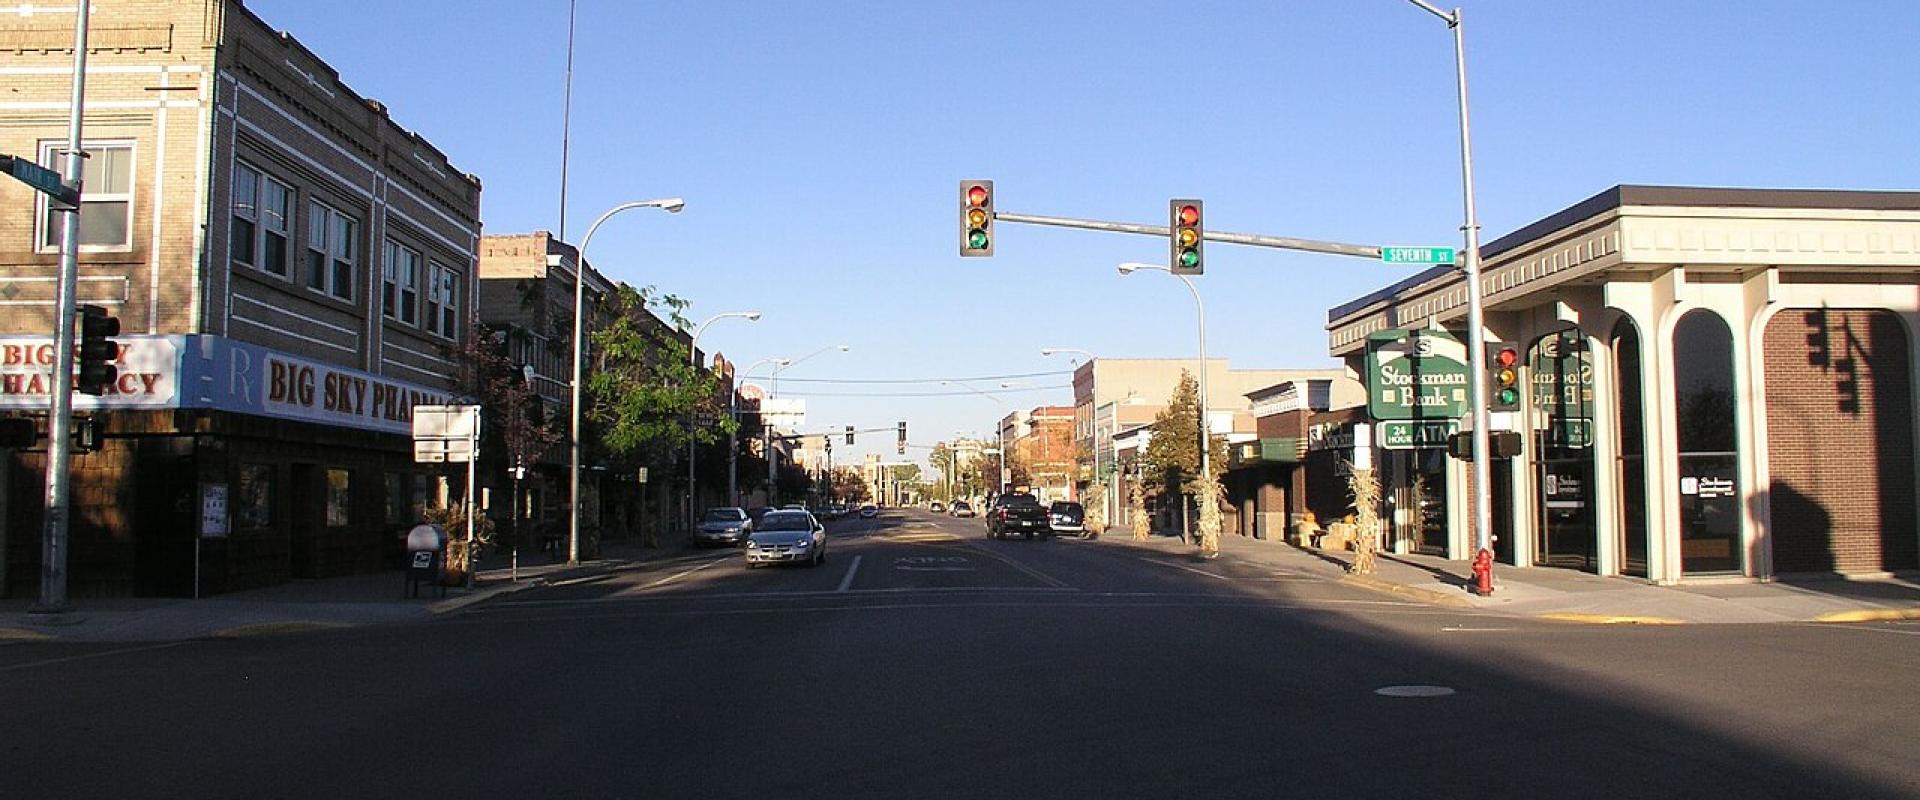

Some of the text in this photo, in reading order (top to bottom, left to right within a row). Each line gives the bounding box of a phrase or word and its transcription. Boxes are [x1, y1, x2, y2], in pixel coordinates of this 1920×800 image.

[1388, 247, 1448, 262] SEVENTH ST
[1381, 366, 1467, 385] Stockman
[269, 358, 315, 408] BIG
[323, 371, 367, 416] SKY
[1399, 387, 1448, 407] Bank
[1388, 436, 1412, 444] HOUR
[1393, 426, 1406, 436] 24
[1415, 425, 1457, 443] ATM
